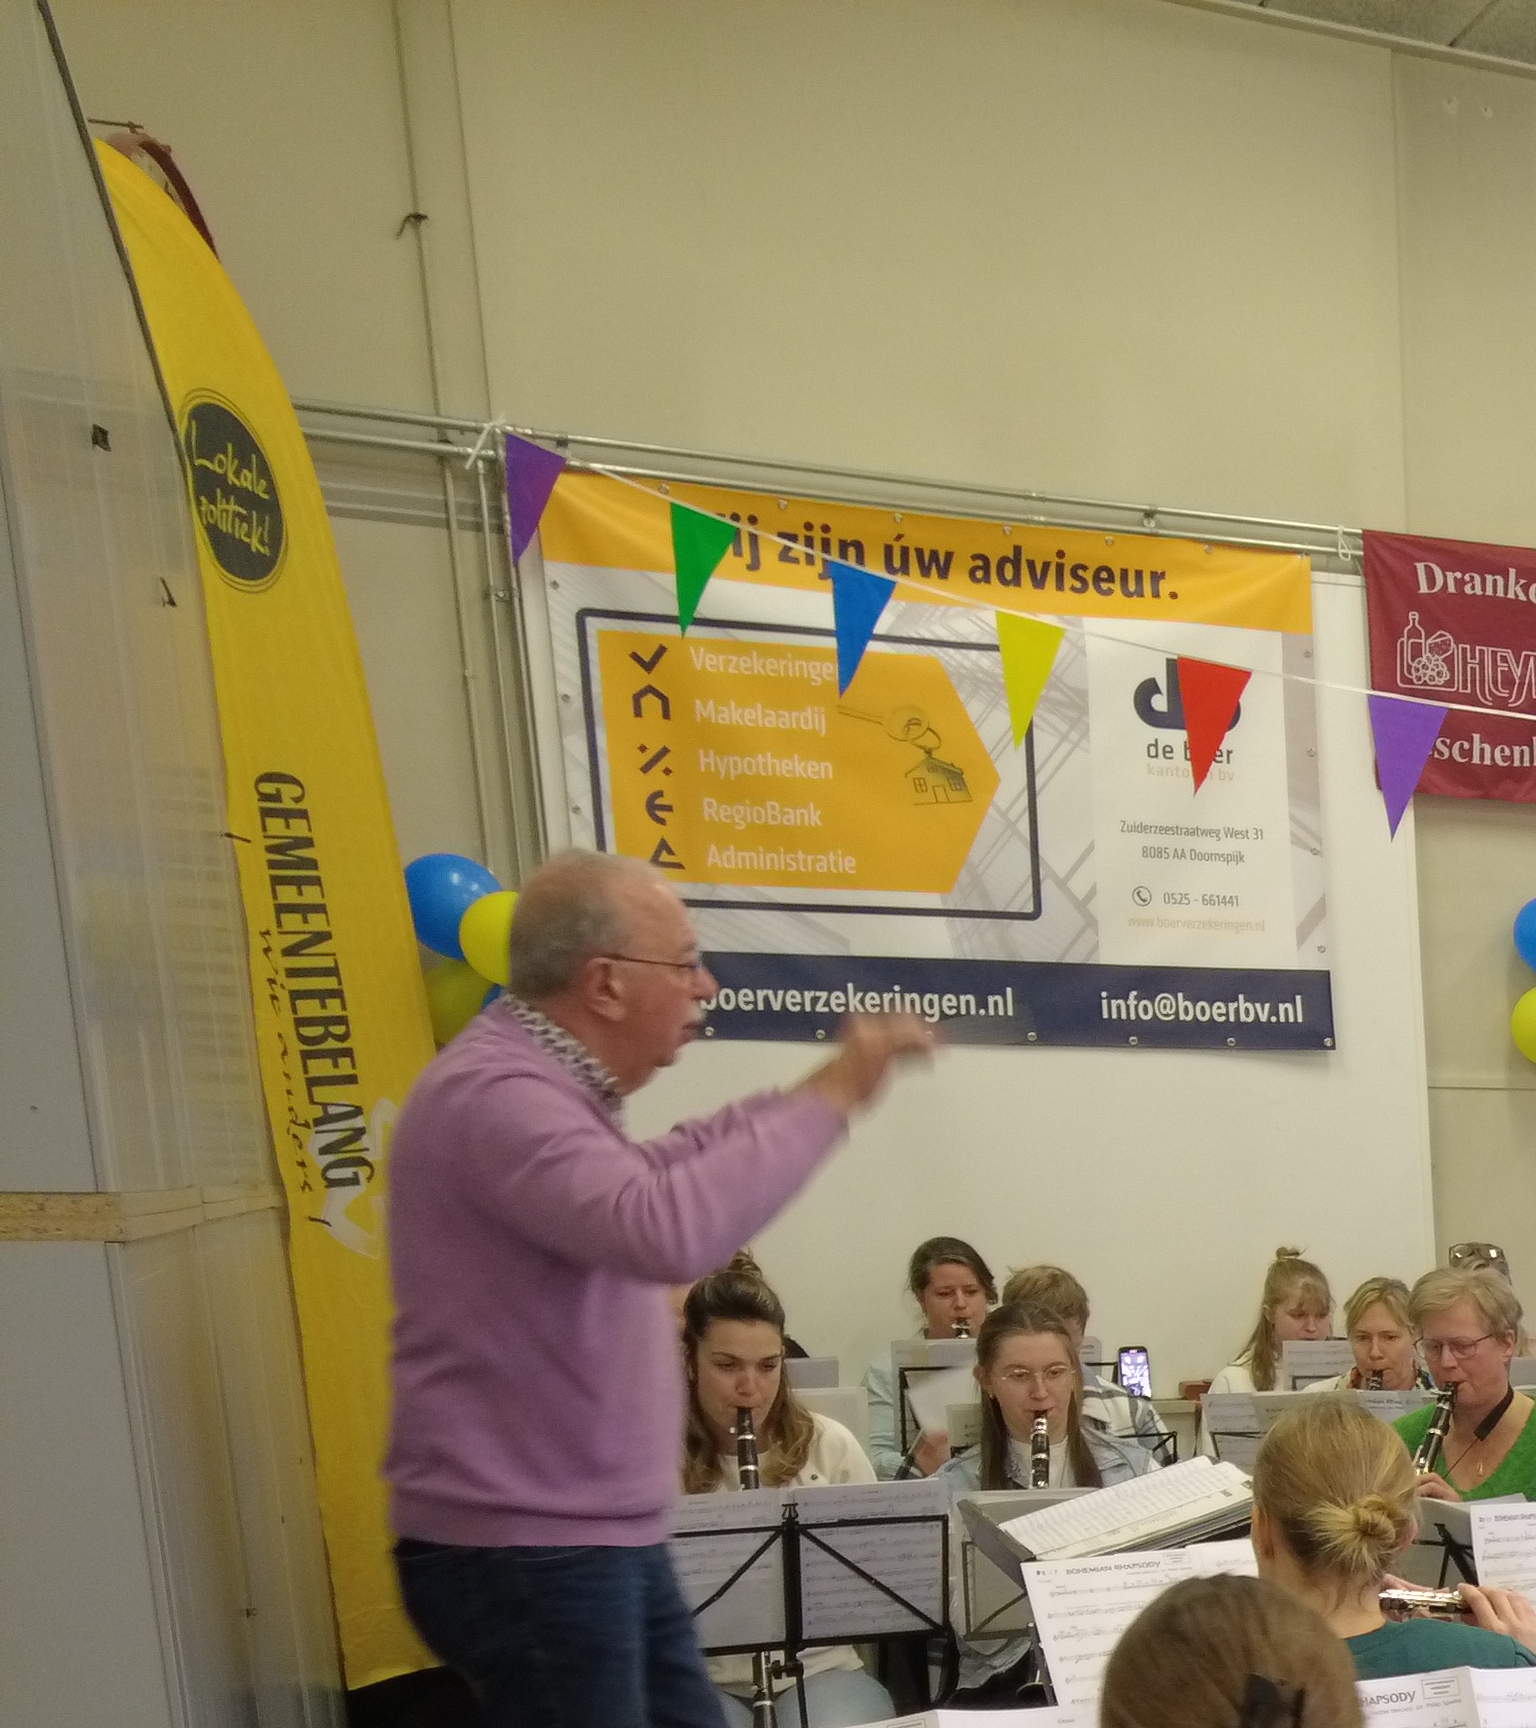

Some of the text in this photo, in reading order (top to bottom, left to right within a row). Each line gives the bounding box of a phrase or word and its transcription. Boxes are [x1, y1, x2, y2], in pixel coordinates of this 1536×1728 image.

[191, 419, 270, 499] Lokale
[717, 512, 1179, 600] ij zijn úw adviseur.
[689, 646, 838, 686] Verzekeringe
[694, 698, 827, 737] Makelaardij
[699, 749, 833, 780] Hypotheken
[1147, 738, 1175, 760] de
[703, 797, 823, 830] RegioBank
[1120, 820, 1264, 841] Zuiderzeestraatweg West 31
[706, 843, 857, 875] Administratie
[1141, 845, 1170, 860] 8085
[1172, 847, 1187, 861] AA
[1163, 891, 1191, 906] 0525
[1201, 892, 1240, 908] 661441
[1100, 991, 1305, 1026] info@boerbv.nl
[1066, 1560, 1161, 1576] BOHEMIAN RHAPSODY
